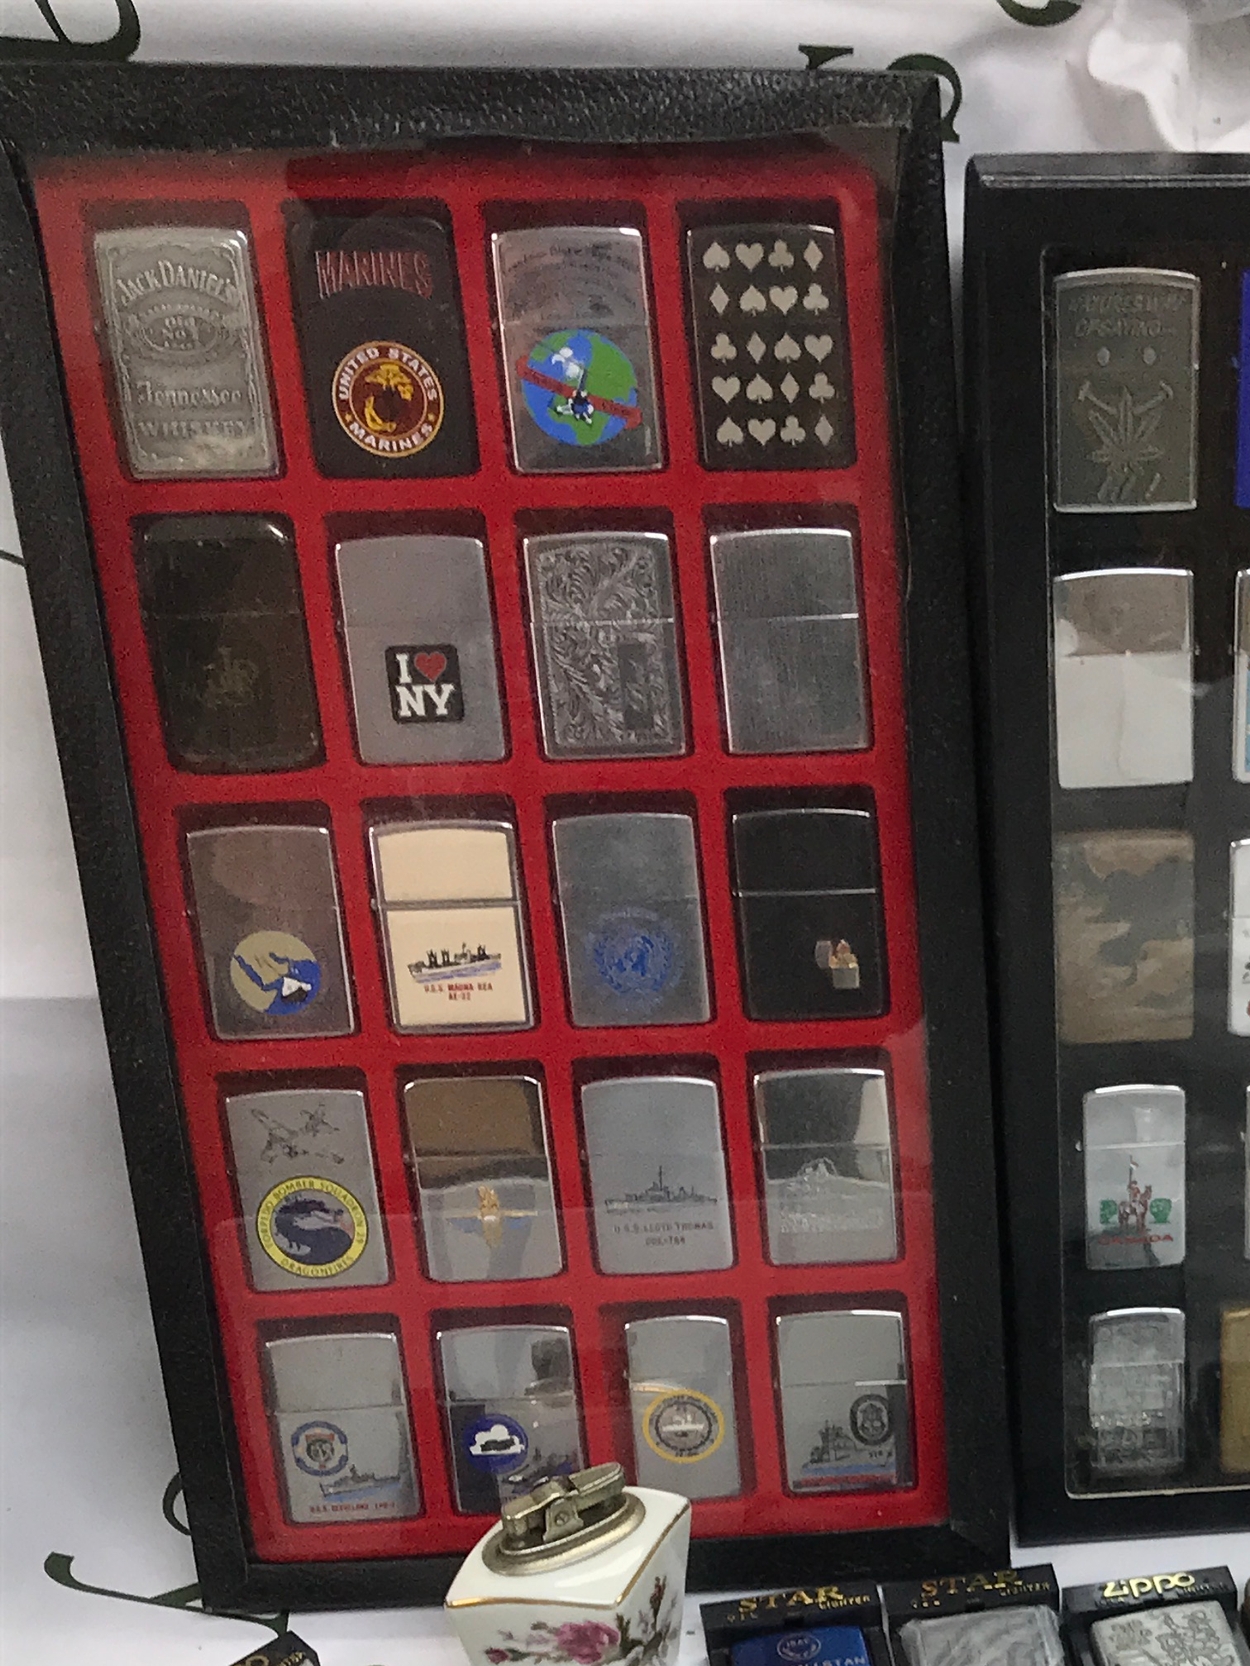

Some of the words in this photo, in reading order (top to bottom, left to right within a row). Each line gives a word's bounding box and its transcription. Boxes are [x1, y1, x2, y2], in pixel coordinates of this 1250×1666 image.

[116, 268, 163, 306] JACK
[157, 259, 238, 302] DANIEL'S
[314, 249, 434, 302] MARINES
[338, 346, 382, 402] UNITED
[387, 346, 439, 402] STATES
[136, 379, 243, 410] Tennessee
[348, 421, 434, 453] MARINES
[394, 653, 413, 685] I
[395, 682, 456, 718] NY
[272, 1180, 315, 1201] BOMBER
[738, 1585, 845, 1614] STAR
[921, 1570, 1024, 1598] STAR
